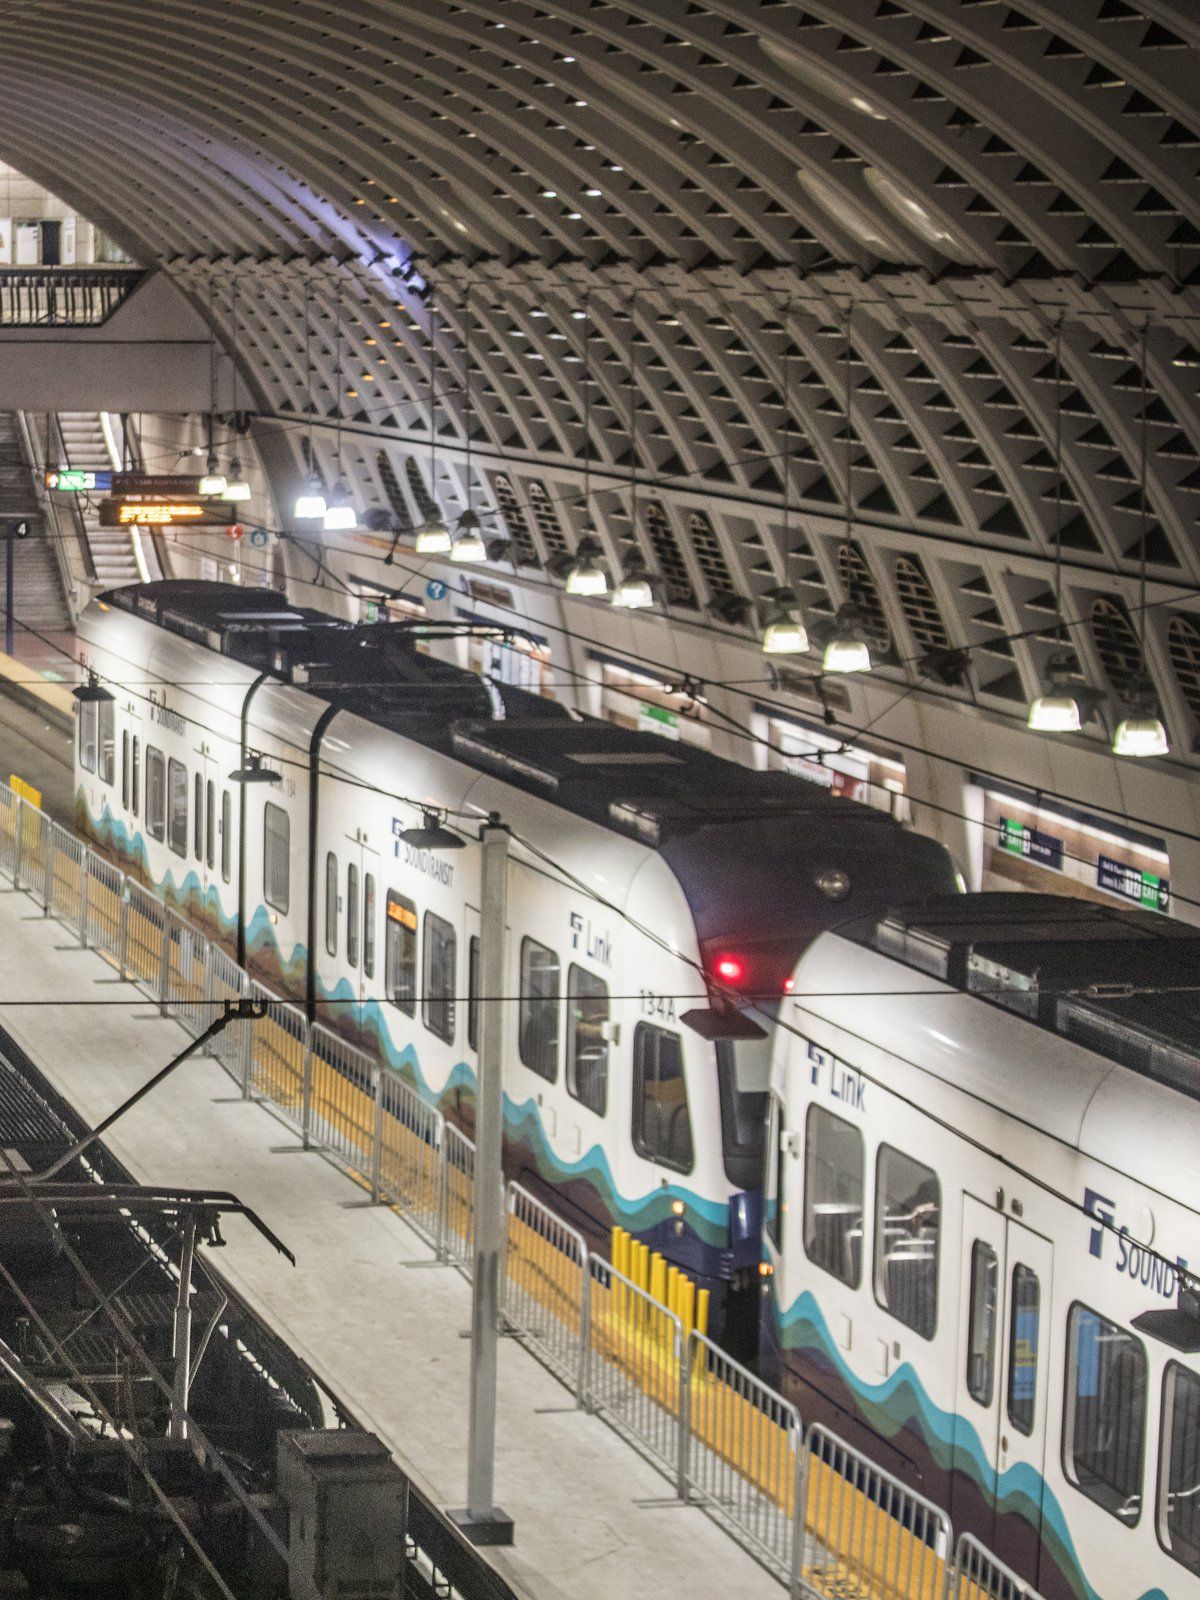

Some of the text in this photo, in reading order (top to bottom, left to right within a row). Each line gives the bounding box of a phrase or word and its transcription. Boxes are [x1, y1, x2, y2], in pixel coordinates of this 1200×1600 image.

[17, 523, 26, 535] 4
[587, 919, 613, 970] Link
[639, 987, 677, 1023] 134A
[830, 1057, 866, 1113] Link
